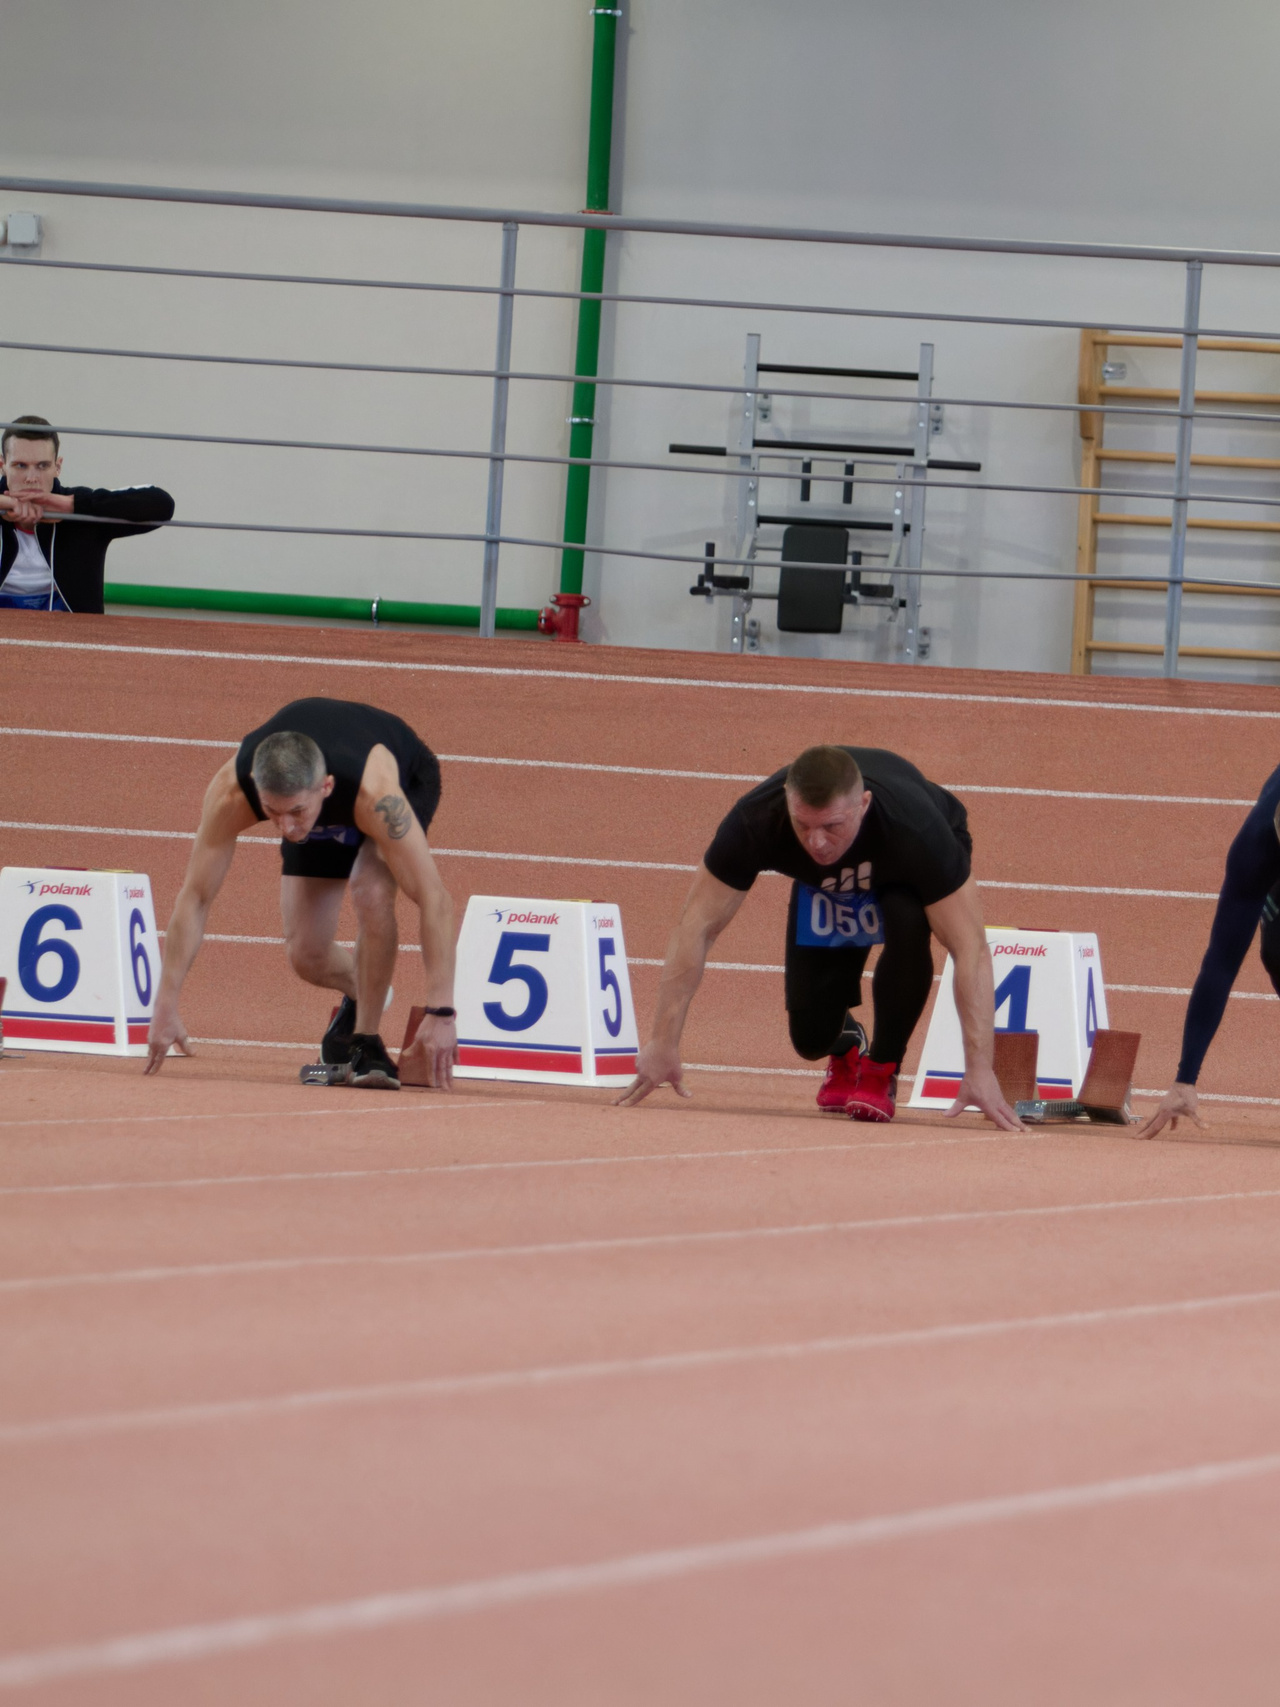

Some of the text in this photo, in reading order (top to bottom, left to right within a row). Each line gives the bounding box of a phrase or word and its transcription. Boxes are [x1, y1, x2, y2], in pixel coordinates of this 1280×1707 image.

[18, 903, 83, 1003] 6
[129, 907, 152, 1007] 6
[811, 892, 880, 937] 050
[482, 931, 551, 1032] 5
[598, 937, 622, 1038] 5
[1085, 966, 1098, 1048] 4
